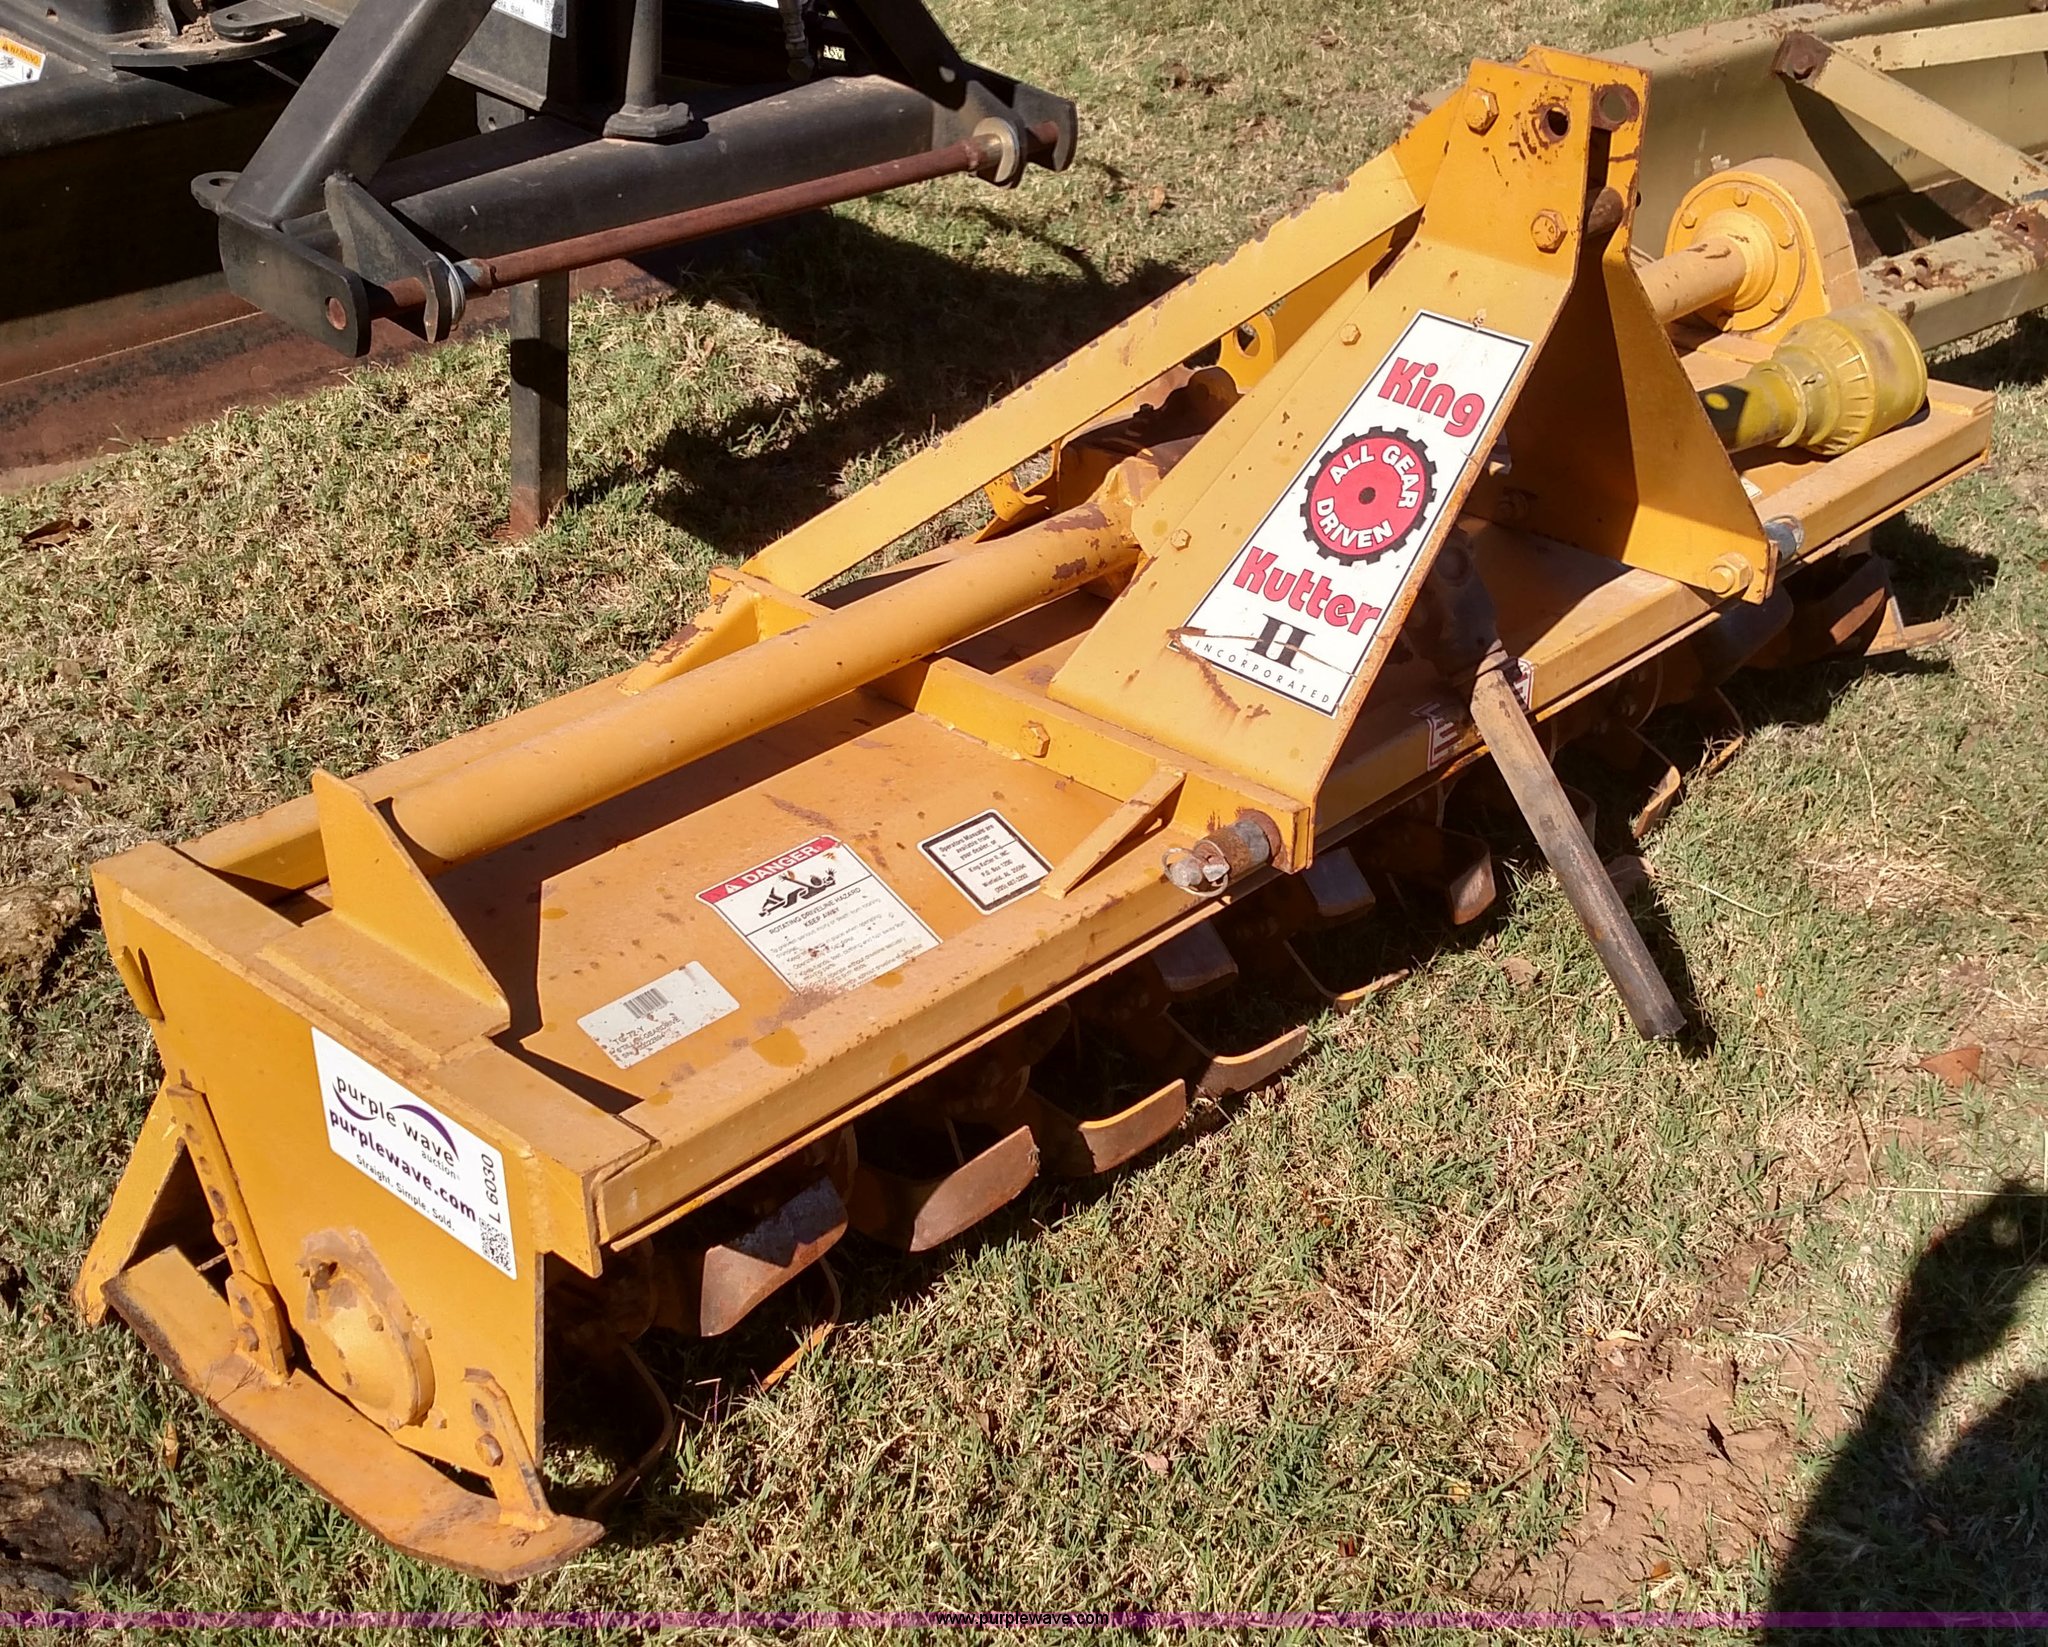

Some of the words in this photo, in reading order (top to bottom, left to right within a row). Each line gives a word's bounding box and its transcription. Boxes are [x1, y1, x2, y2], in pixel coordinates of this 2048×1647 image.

[1377, 357, 1486, 438] King
[1328, 445, 1375, 486] ALL
[1381, 445, 1421, 510] GEAR
[1316, 497, 1395, 549] DRIVEN
[1233, 546, 1382, 636] Kutter
[1195, 640, 1330, 703] INCORPORATED
[742, 845, 819, 884] DANGER
[769, 915, 801, 935] ROTATING
[801, 900, 835, 920] DRIVELINE
[835, 887, 861, 902] HAZARD
[804, 916, 821, 928] KEEP
[822, 907, 840, 918] AWAY
[336, 1075, 397, 1128] purple
[403, 1121, 455, 1167] wave
[329, 1108, 476, 1223] purplewave.com
[356, 1154, 394, 1189] Straight.
[396, 1182, 431, 1214] Simple.
[432, 1208, 455, 1232] Sold.
[421, 1150, 457, 1179] auction
[481, 1153, 499, 1206] 6030
[489, 1212, 501, 1224] L
